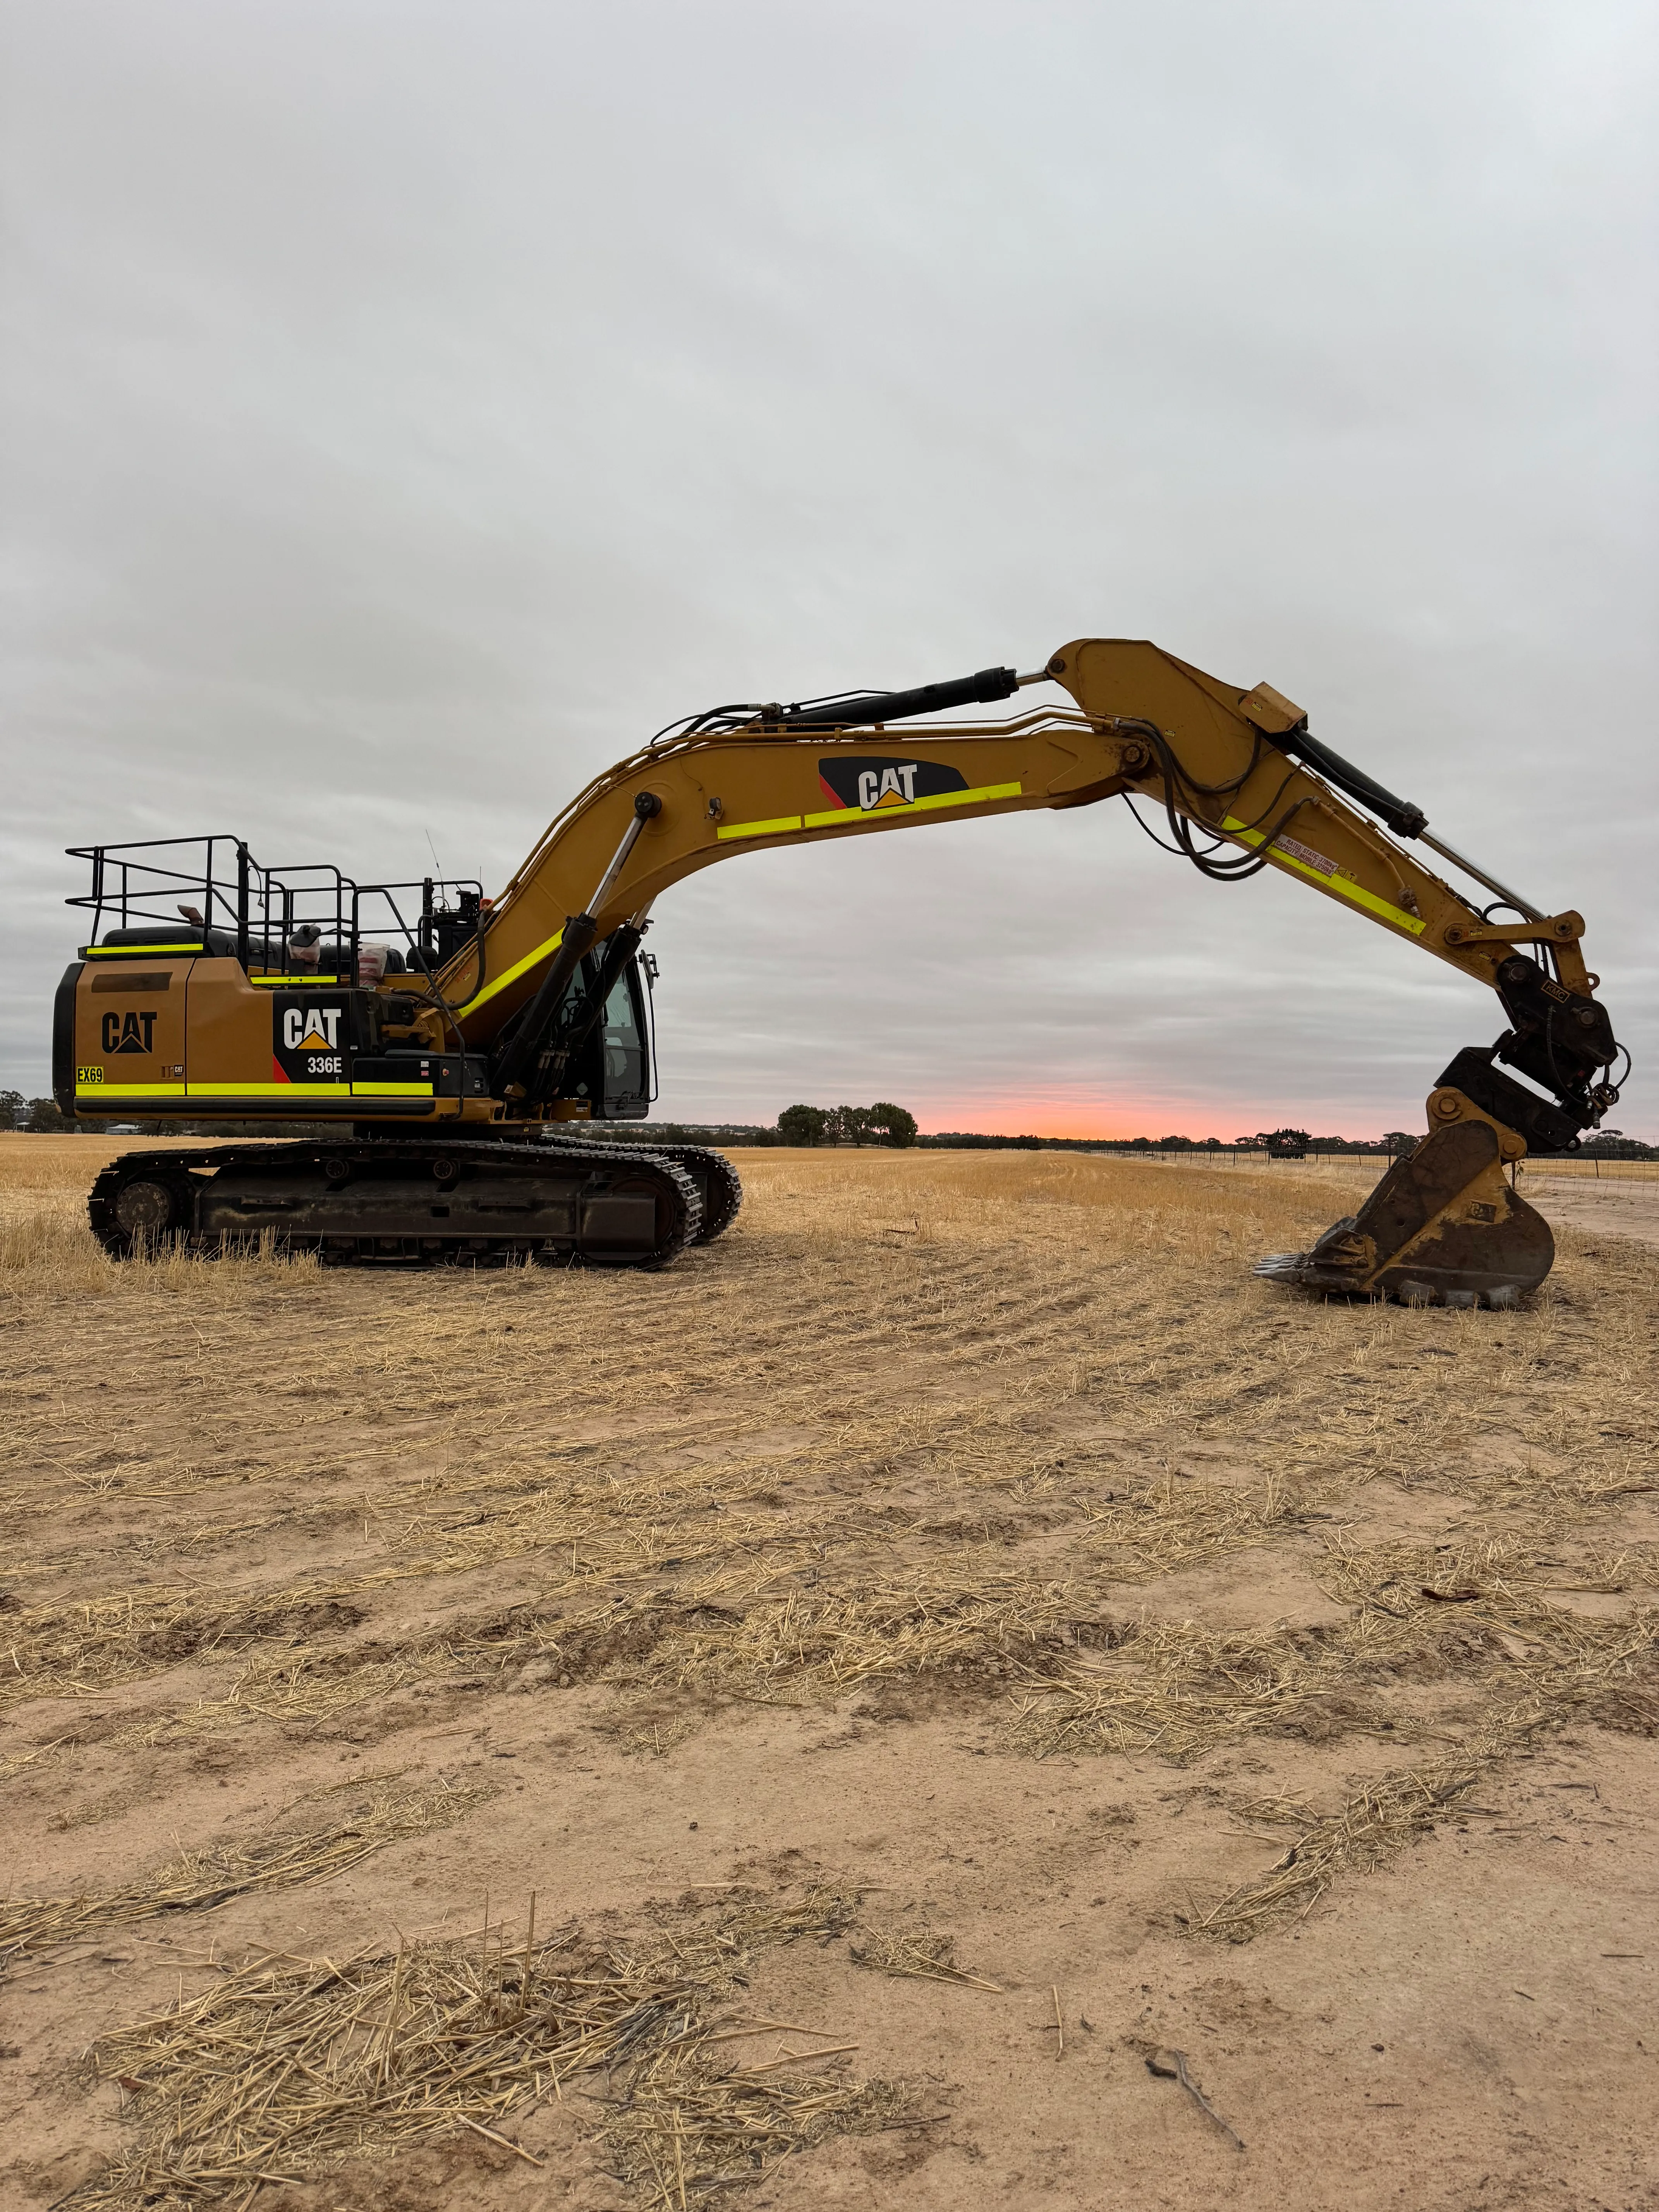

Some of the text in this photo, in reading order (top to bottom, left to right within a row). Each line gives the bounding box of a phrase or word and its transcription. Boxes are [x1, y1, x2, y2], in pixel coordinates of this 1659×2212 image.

[858, 764, 917, 809] CAT
[1276, 841, 1299, 855] CAPACITY
[1286, 839, 1302, 850] RATED
[1546, 984, 1565, 999] KMC
[102, 1012, 157, 1053] CAT
[284, 1008, 341, 1049] CAT
[307, 1057, 342, 1073] 336E
[77, 1068, 103, 1082] EX69
